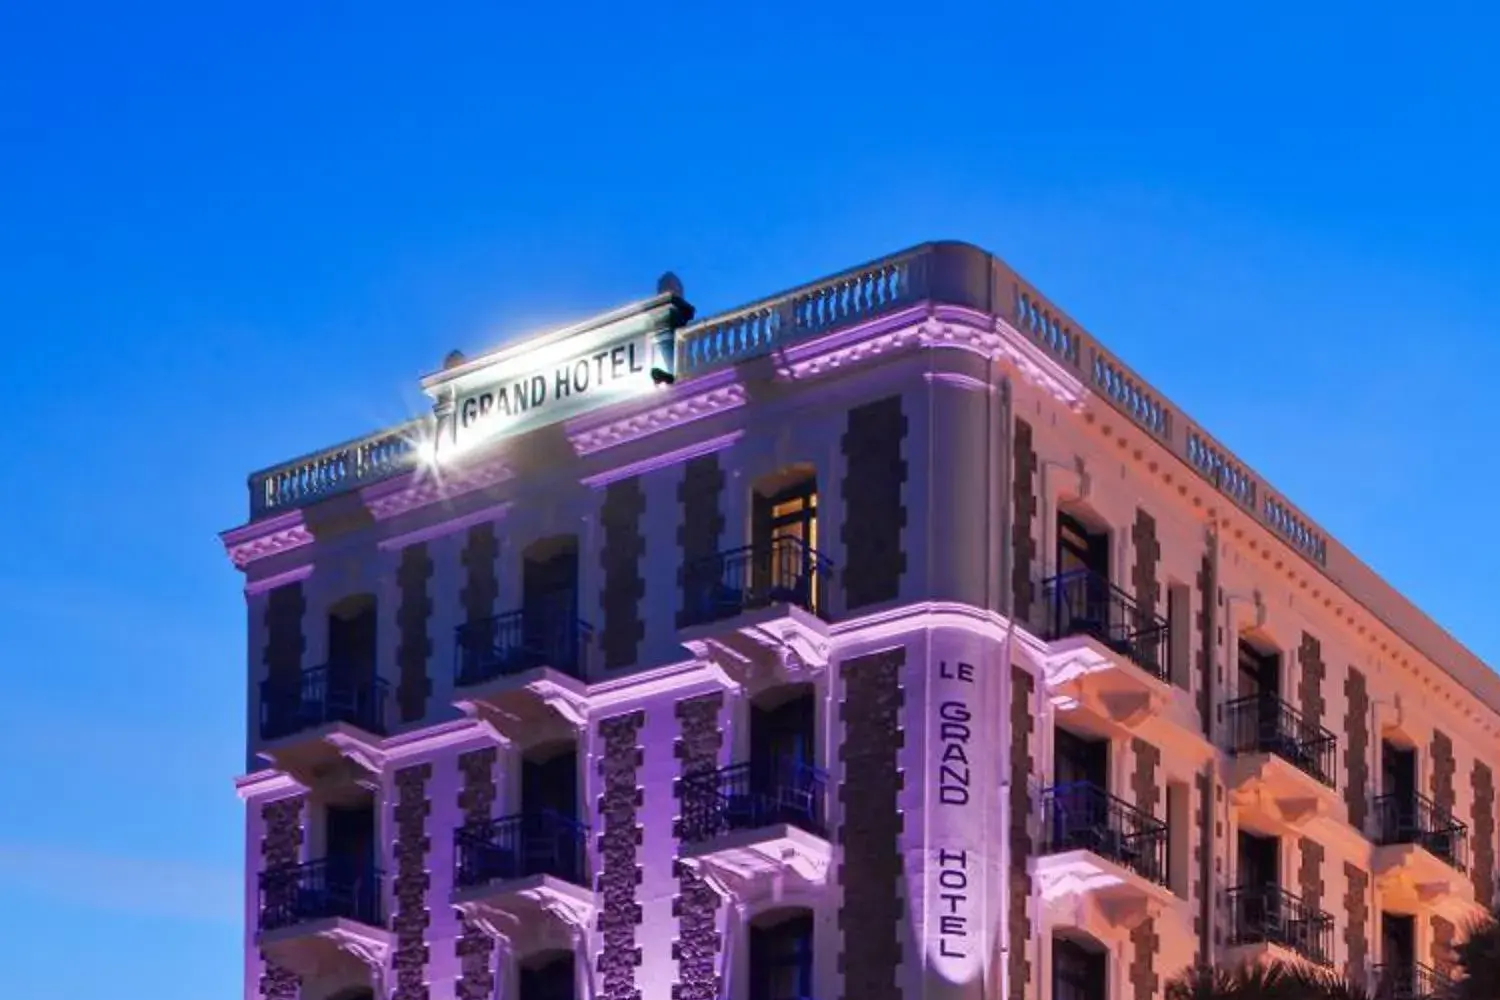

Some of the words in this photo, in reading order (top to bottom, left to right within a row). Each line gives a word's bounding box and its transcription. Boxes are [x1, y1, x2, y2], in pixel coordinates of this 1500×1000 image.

[462, 374, 547, 428] GRAND
[555, 343, 643, 401] HOTEL
[939, 661, 974, 683] LE
[939, 701, 971, 805] GRAND
[940, 848, 967, 959] HOTEL
